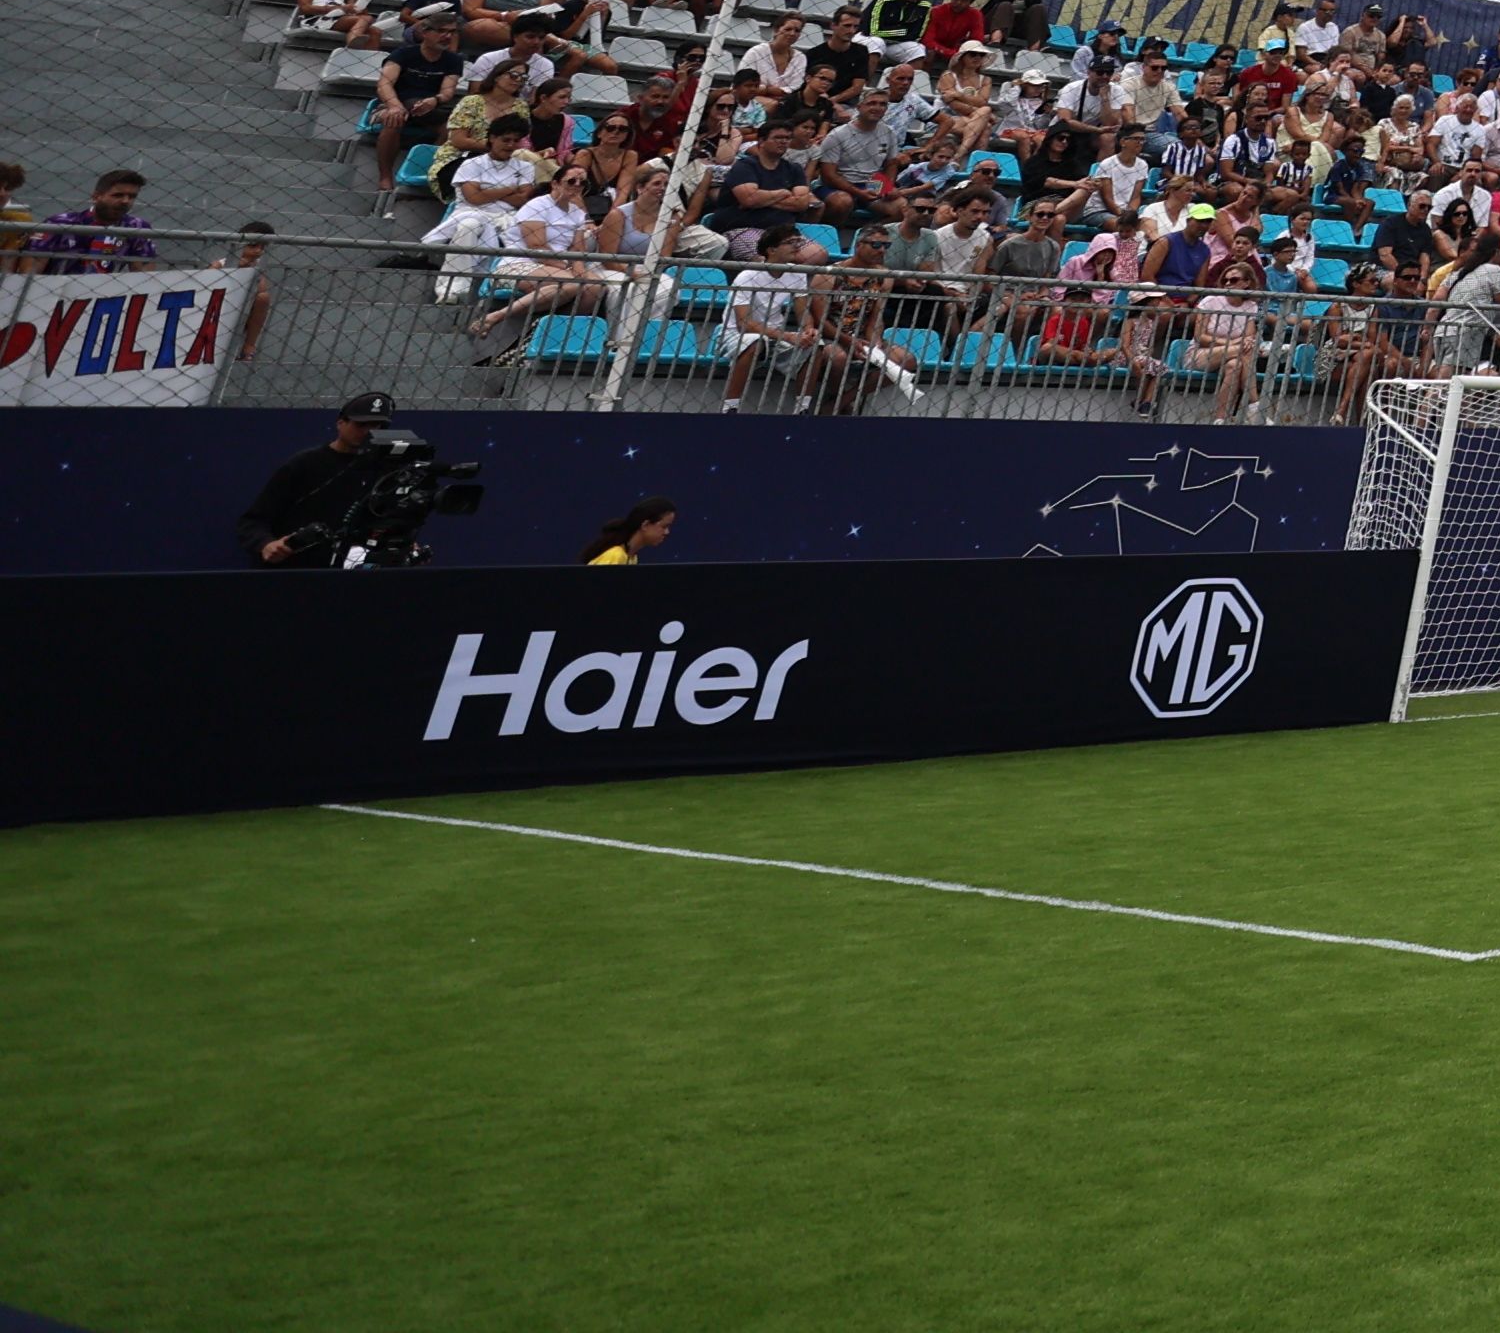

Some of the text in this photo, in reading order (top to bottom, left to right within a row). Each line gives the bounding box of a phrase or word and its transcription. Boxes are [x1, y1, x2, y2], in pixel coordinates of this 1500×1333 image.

[44, 288, 226, 379] VOLTA
[424, 620, 809, 741] Haier
[1143, 591, 1251, 705] MG
